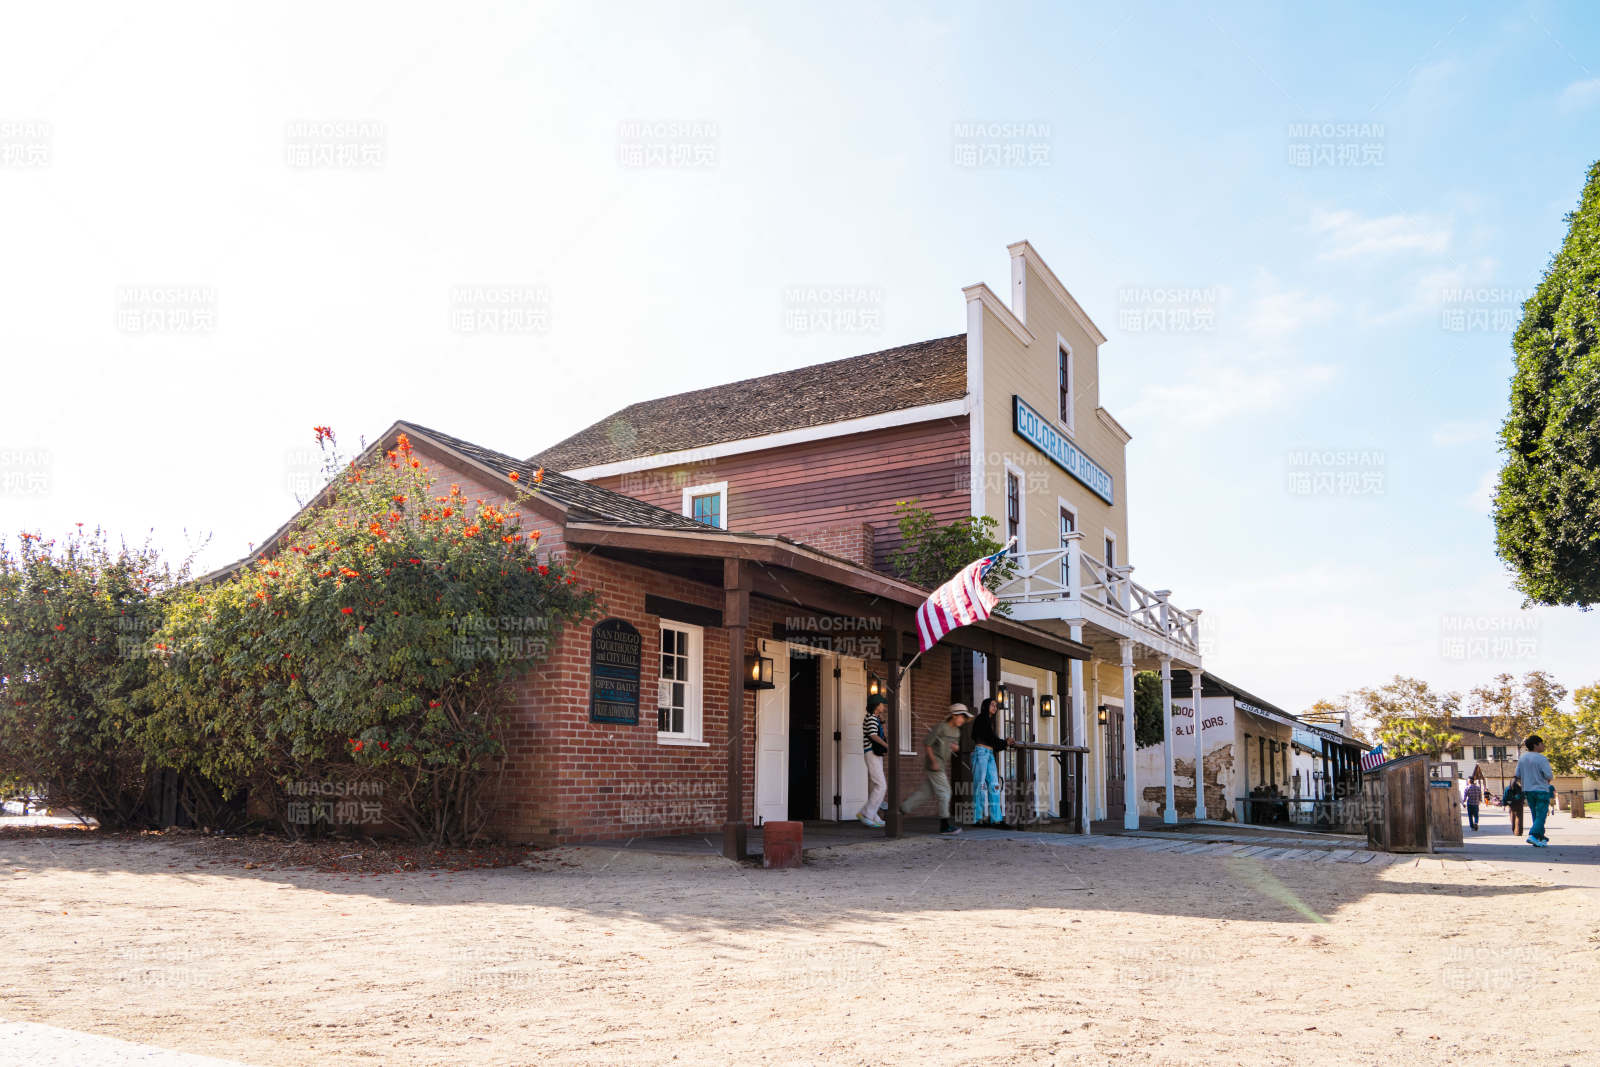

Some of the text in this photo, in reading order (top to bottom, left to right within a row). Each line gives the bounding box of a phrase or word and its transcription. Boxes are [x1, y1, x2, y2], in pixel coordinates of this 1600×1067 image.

[1019, 405, 1077, 471] COLORADO
[595, 628, 639, 645] SAN DIEGO
[607, 652, 620, 663] CITY
[595, 679, 637, 692] OPEN DAILY
[1176, 726, 1184, 736] &
